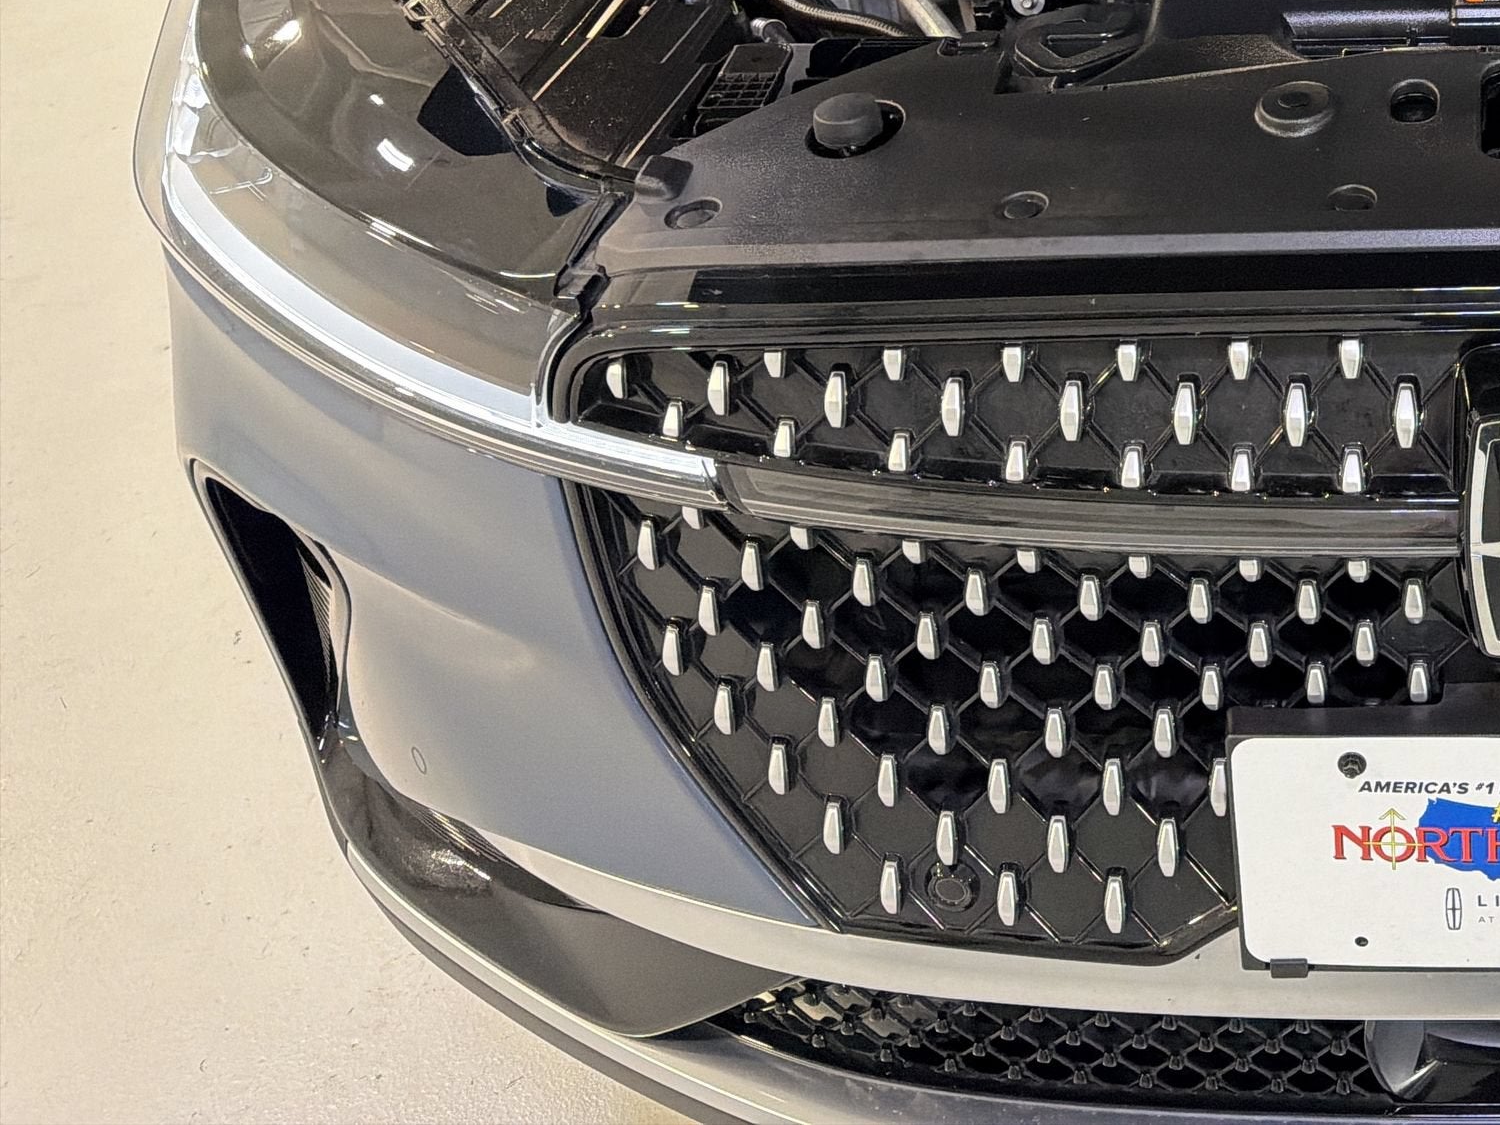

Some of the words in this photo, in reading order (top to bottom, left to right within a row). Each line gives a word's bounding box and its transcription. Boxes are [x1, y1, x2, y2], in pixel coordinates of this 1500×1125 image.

[1358, 780, 1469, 795] AMERICA'S
[1475, 782, 1495, 795] #1
[1477, 916, 1496, 924] AT
